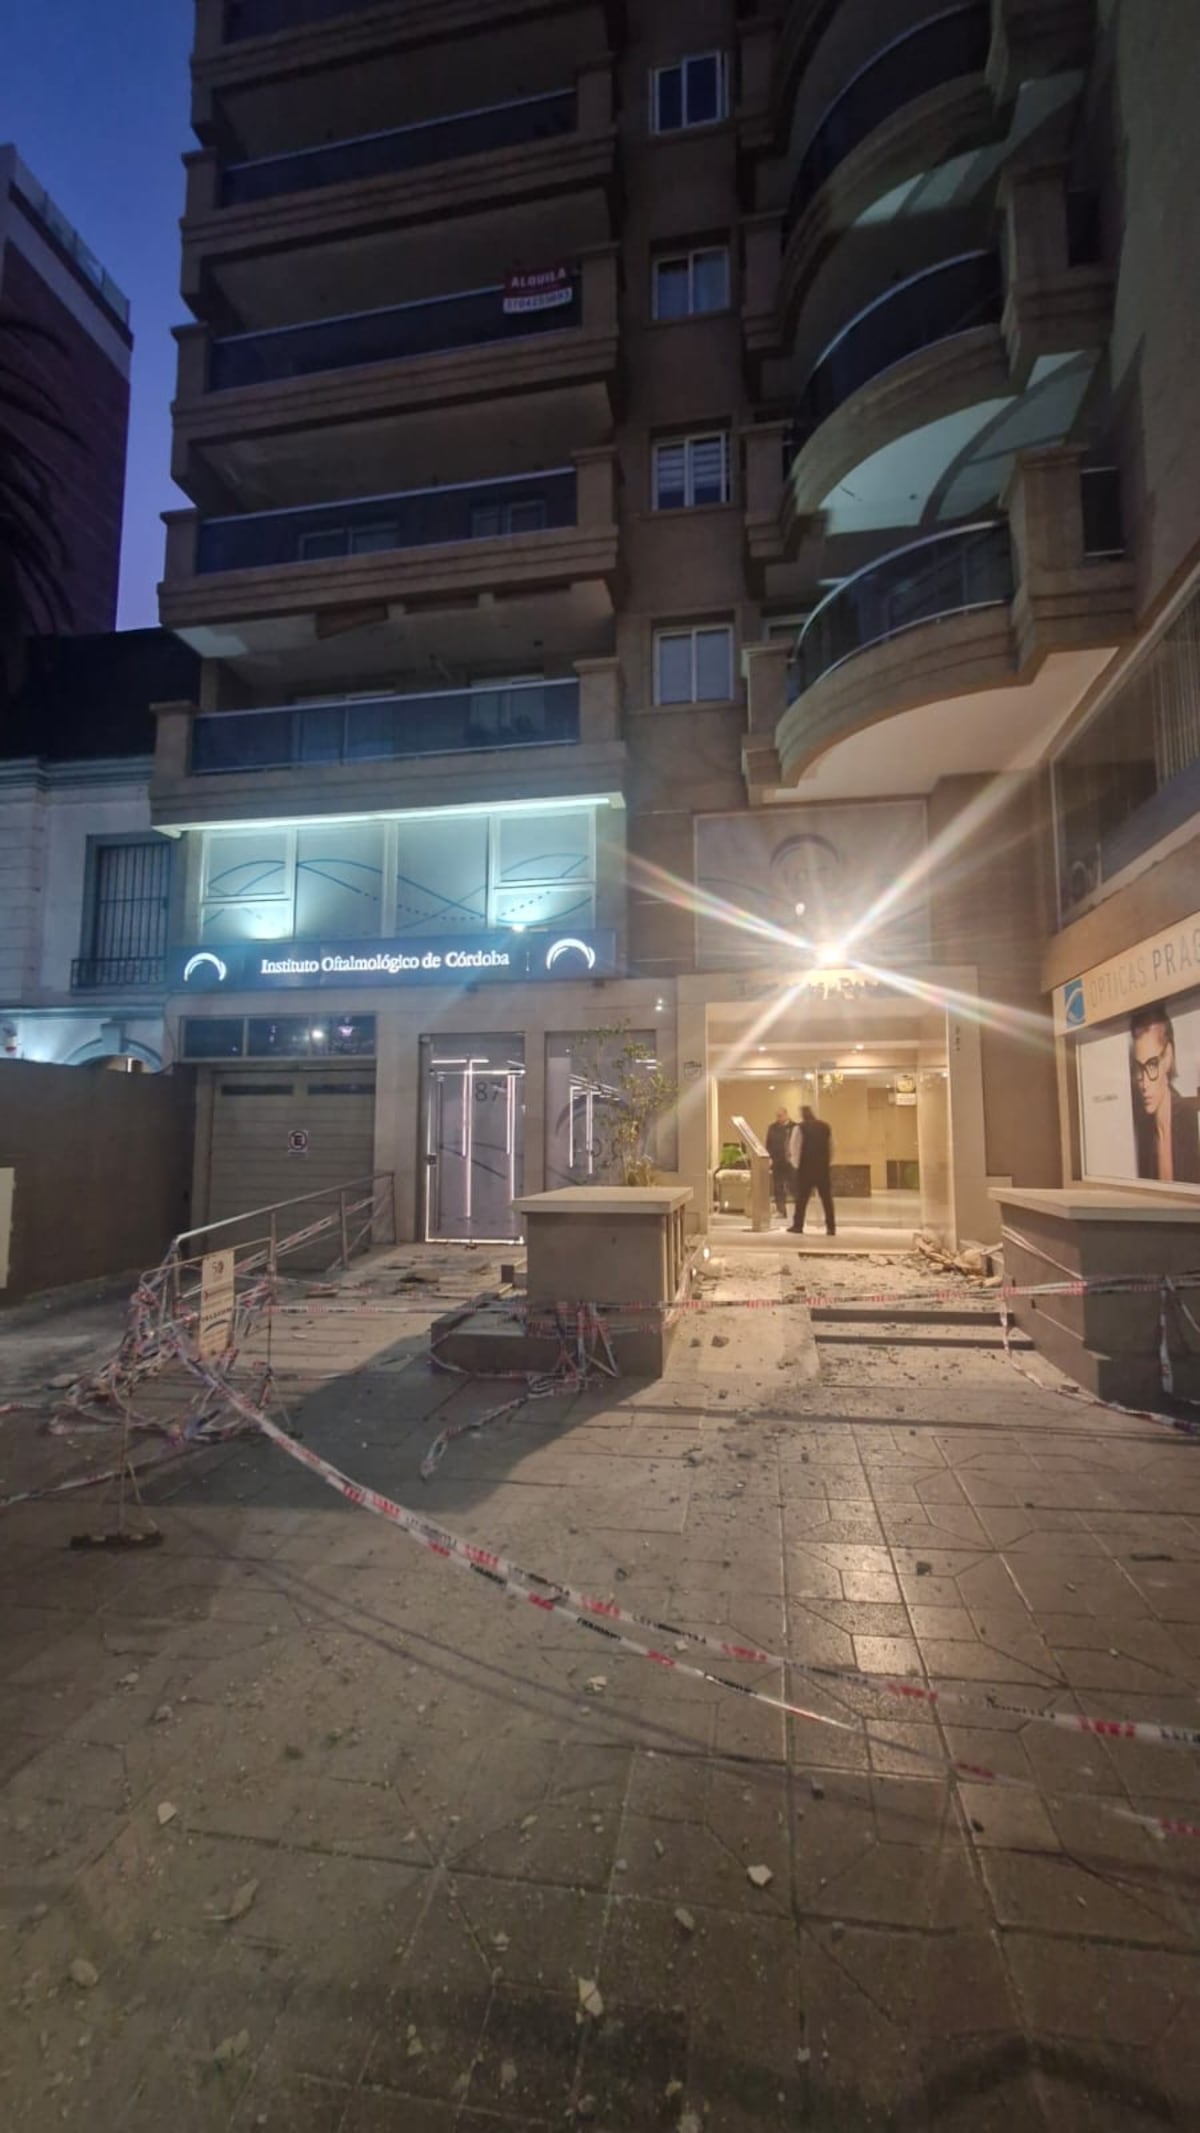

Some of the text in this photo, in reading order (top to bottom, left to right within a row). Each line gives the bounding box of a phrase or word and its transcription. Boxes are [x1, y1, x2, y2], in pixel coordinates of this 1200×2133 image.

[511, 267, 566, 289] ALQUILA
[261, 950, 510, 974] Instituto Oftalmológico de Córdoba
